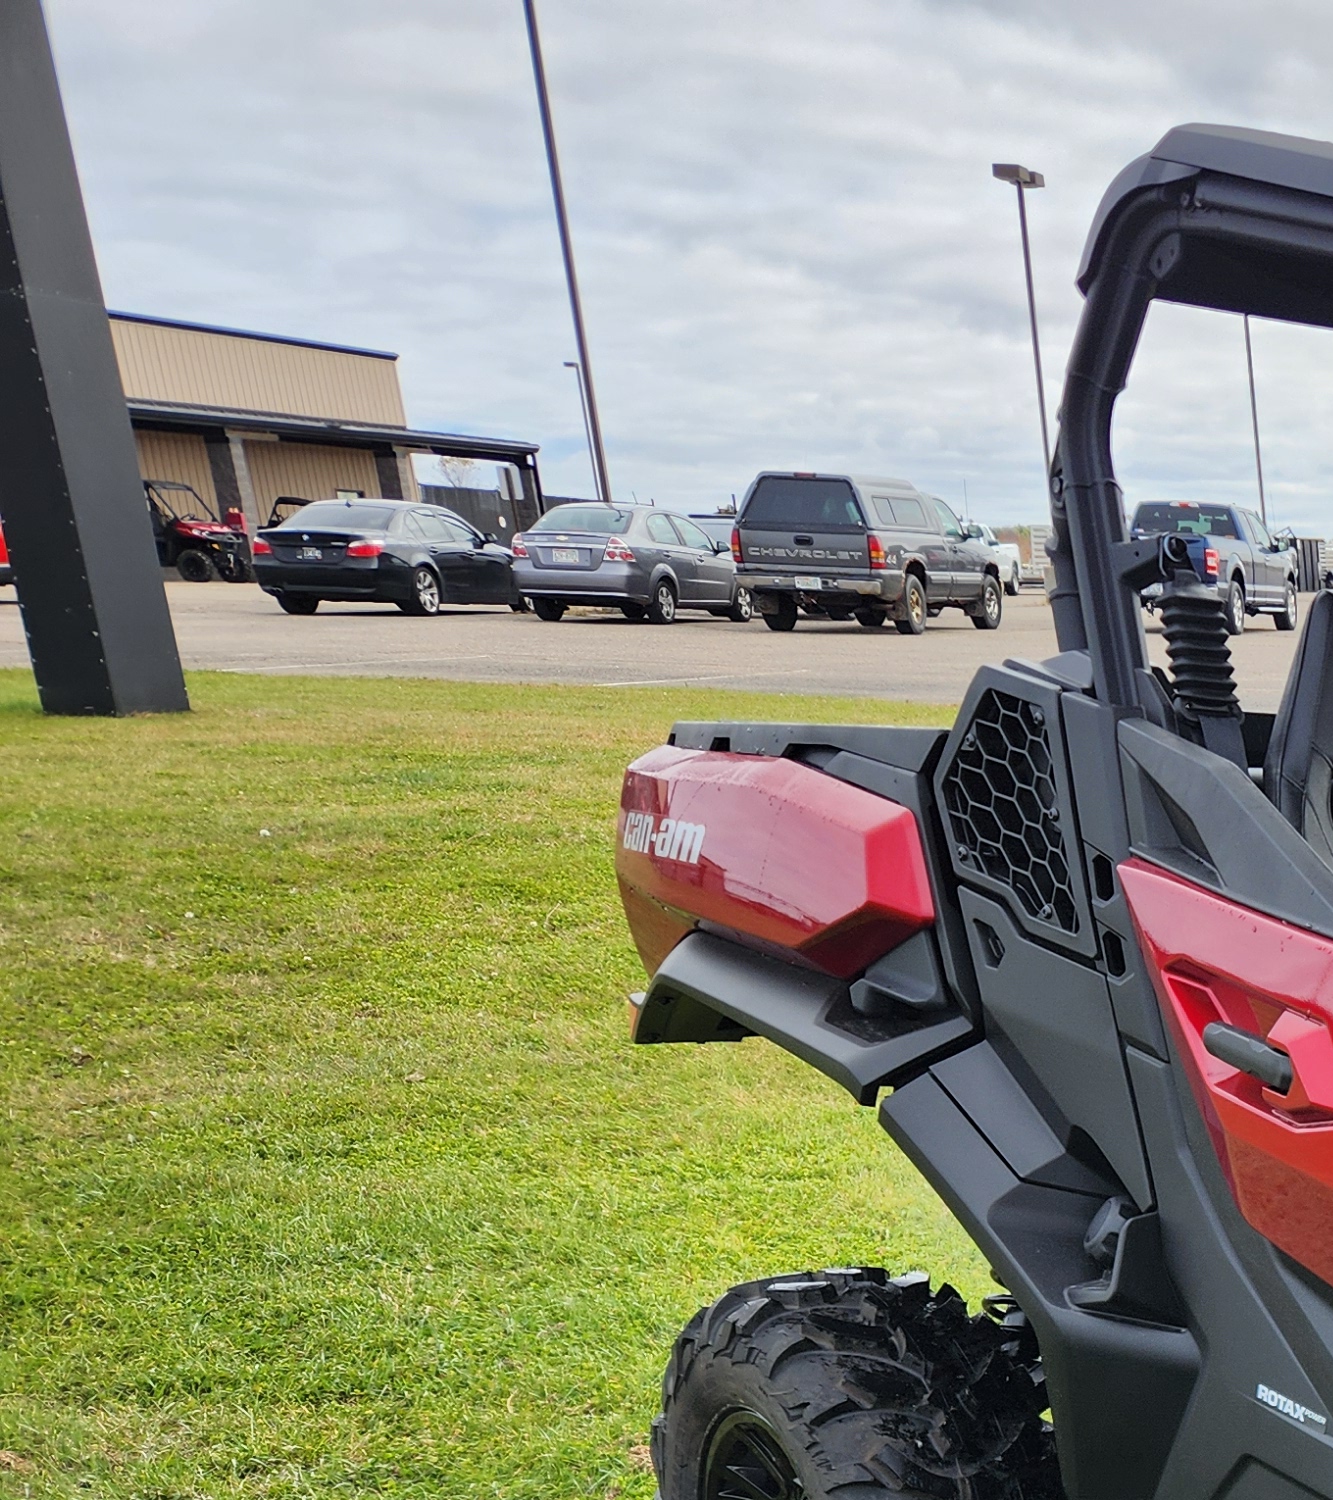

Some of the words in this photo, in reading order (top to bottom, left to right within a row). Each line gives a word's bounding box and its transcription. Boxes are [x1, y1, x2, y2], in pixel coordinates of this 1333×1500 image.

[747, 546, 863, 561] CHEVROLET
[1256, 1383, 1306, 1423] ROTAX
[1304, 1409, 1327, 1425] POWER
